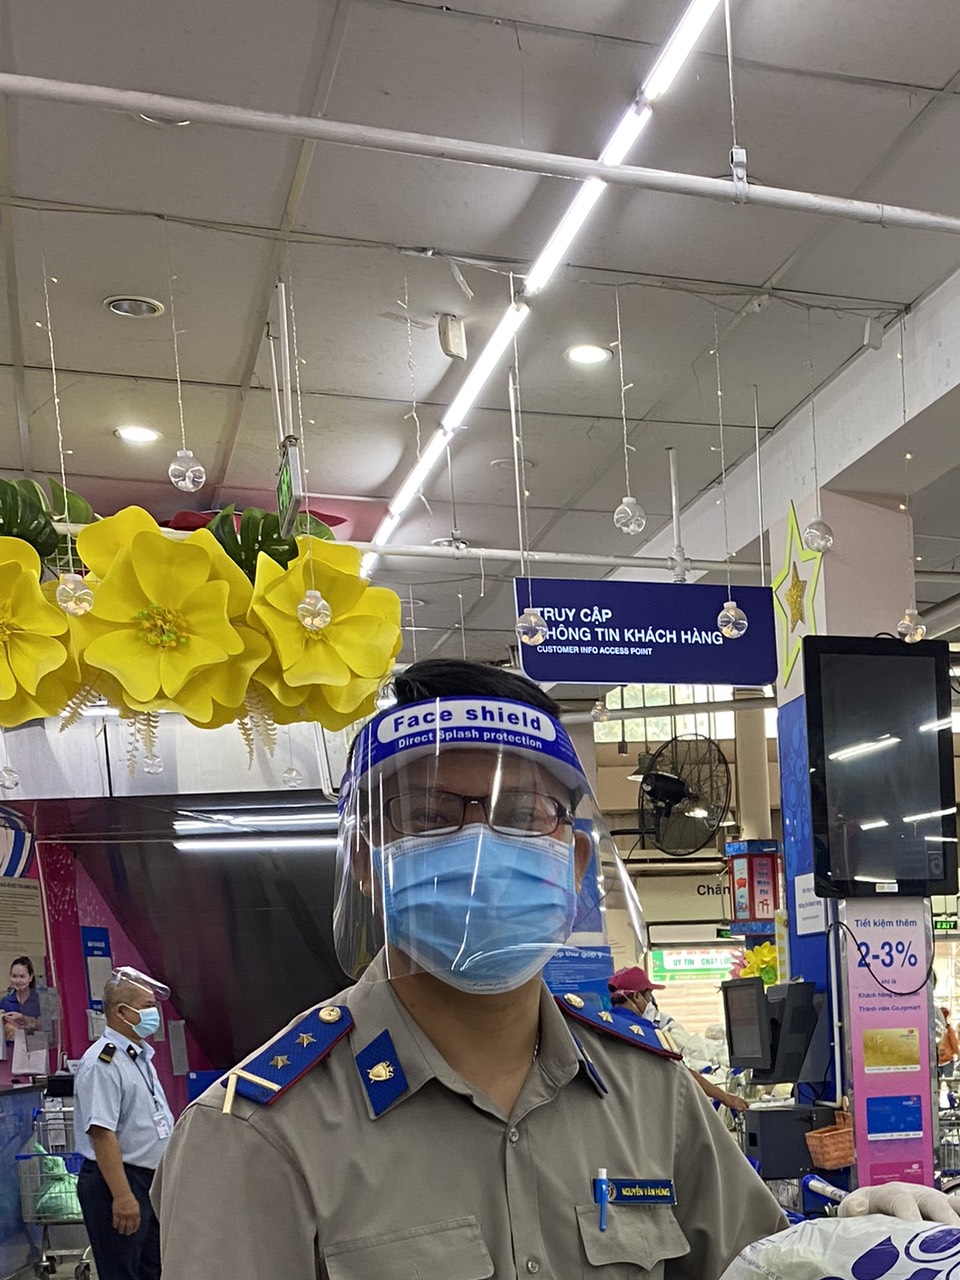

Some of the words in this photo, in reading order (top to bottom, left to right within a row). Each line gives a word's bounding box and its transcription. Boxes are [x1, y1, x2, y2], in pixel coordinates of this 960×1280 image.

[535, 607, 576, 622] TRUY
[580, 606, 613, 625] CẬP
[546, 624, 591, 643] HÔNG
[595, 627, 620, 642] TIN
[624, 623, 679, 644] KHÁCH
[681, 627, 724, 645] HÀNG
[537, 645, 579, 654] CUSTOMER
[580, 646, 599, 654] INFO
[599, 647, 630, 655] ACCESS
[630, 648, 653, 656] POINT
[393, 707, 453, 732] Face
[465, 705, 542, 732] shield
[397, 731, 435, 749] Direct
[438, 729, 480, 744] Splash
[482, 730, 543, 749] protection
[855, 918, 871, 928] Tiết
[873, 918, 895, 929] kiệm
[896, 919, 918, 928] thêm
[935, 921, 955, 930] EXIT
[857, 940, 918, 968] 2-3%
[644, 1186, 655, 1196] VĂN
